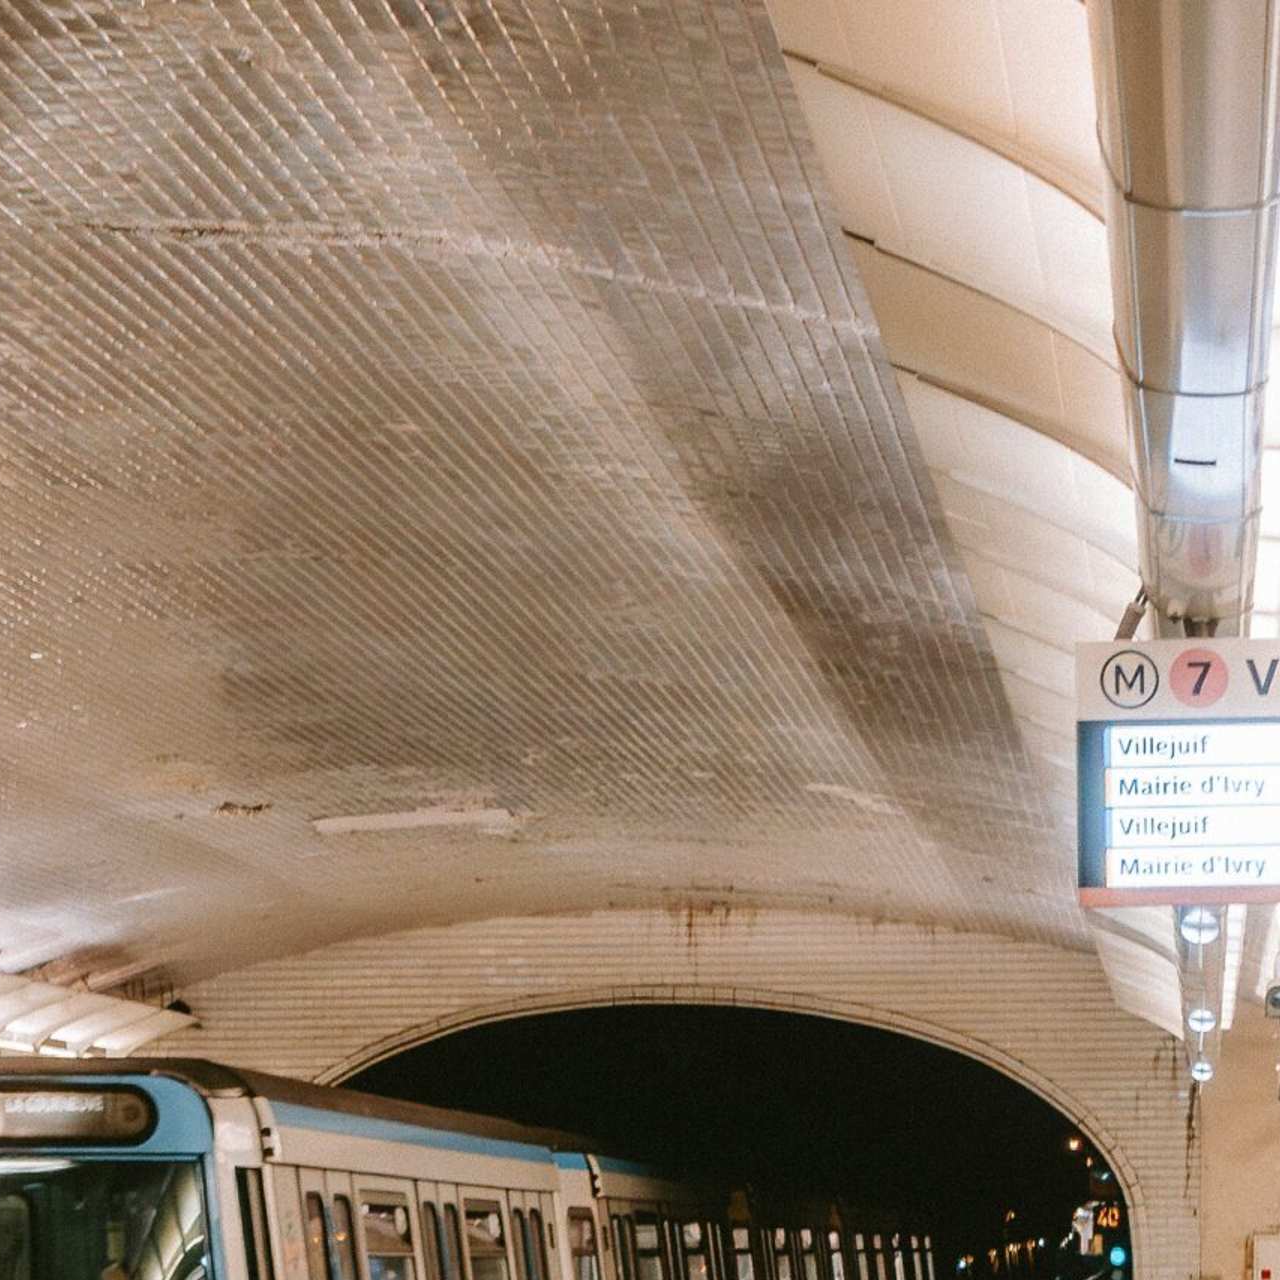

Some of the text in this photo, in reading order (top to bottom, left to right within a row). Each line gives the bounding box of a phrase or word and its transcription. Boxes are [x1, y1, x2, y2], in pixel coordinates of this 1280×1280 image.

[1187, 661, 1211, 696] 7
[1118, 735, 1209, 759] Villejuif
[1118, 776, 1192, 796] Mairie
[1201, 774, 1266, 797] d'Ivry
[1119, 816, 1209, 839] Villejuif
[1119, 856, 1193, 876] Mairie
[1201, 854, 1267, 877] d'Ivry
